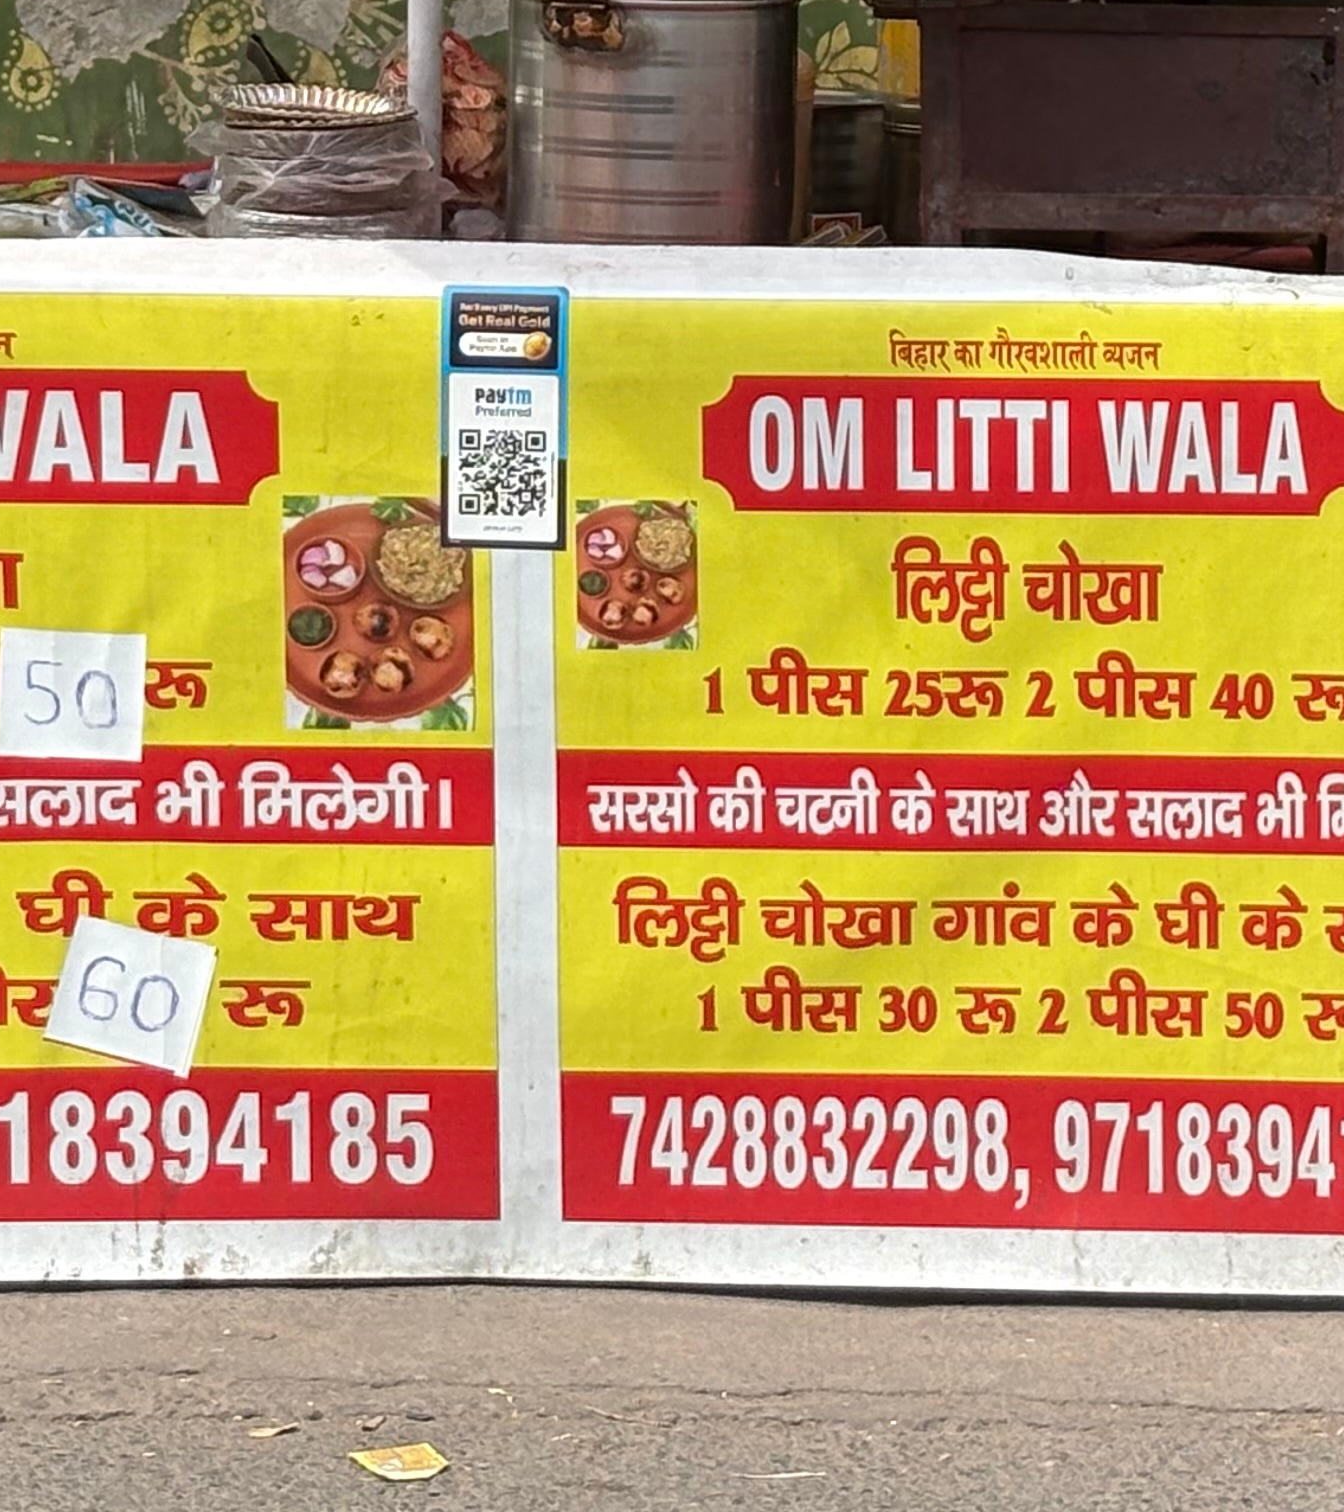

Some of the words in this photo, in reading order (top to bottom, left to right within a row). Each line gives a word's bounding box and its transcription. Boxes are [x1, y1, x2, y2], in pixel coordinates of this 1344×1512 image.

[459, 314, 483, 327] Get
[486, 314, 515, 328] Real
[518, 315, 551, 328] Gold
[889, 329, 949, 371] बिहार
[954, 340, 982, 369] का
[988, 328, 1097, 374] गौरवशाली
[1102, 342, 1162, 370] व्यजन
[475, 405, 532, 418] Preferred
[749, 395, 863, 491] OM
[896, 398, 1070, 492] LITTI
[1097, 400, 1308, 495] WALA
[891, 536, 1010, 642] लिट्टी
[1023, 541, 1163, 624] चोखा
[24, 660, 118, 730] 50
[703, 666, 723, 714] 1
[747, 647, 869, 716] पीस
[1026, 671, 1055, 717] 2
[1074, 649, 1197, 719] पीस
[1210, 674, 1274, 720] 40
[156, 761, 224, 828] भी
[587, 767, 698, 833] सरसो
[707, 765, 767, 833] की
[776, 767, 881, 836] चटनी
[891, 770, 936, 835] के
[946, 789, 1029, 836] साथ
[1038, 767, 1119, 836] और
[1126, 791, 1246, 840] सलाद
[1257, 771, 1307, 838] भी
[17, 869, 113, 936] घी
[134, 872, 226, 938] के
[248, 895, 421, 941] साथ
[613, 876, 745, 963] लिट्टी
[760, 879, 917, 949] चोखा
[932, 881, 1056, 947] गांव
[1070, 881, 1139, 948] के
[1155, 881, 1224, 950] घी
[1239, 884, 1308, 951] के
[78, 956, 180, 1033] 60
[220, 980, 311, 1027] रू
[697, 985, 717, 1031] 1
[740, 965, 862, 1031] पीस
[879, 987, 937, 1033] 30
[954, 987, 1021, 1034] रू
[1038, 989, 1069, 1034] 2
[1087, 968, 1208, 1038] पीस
[1225, 992, 1283, 1039] 50
[611, 1095, 1031, 1210] 7428832298,
